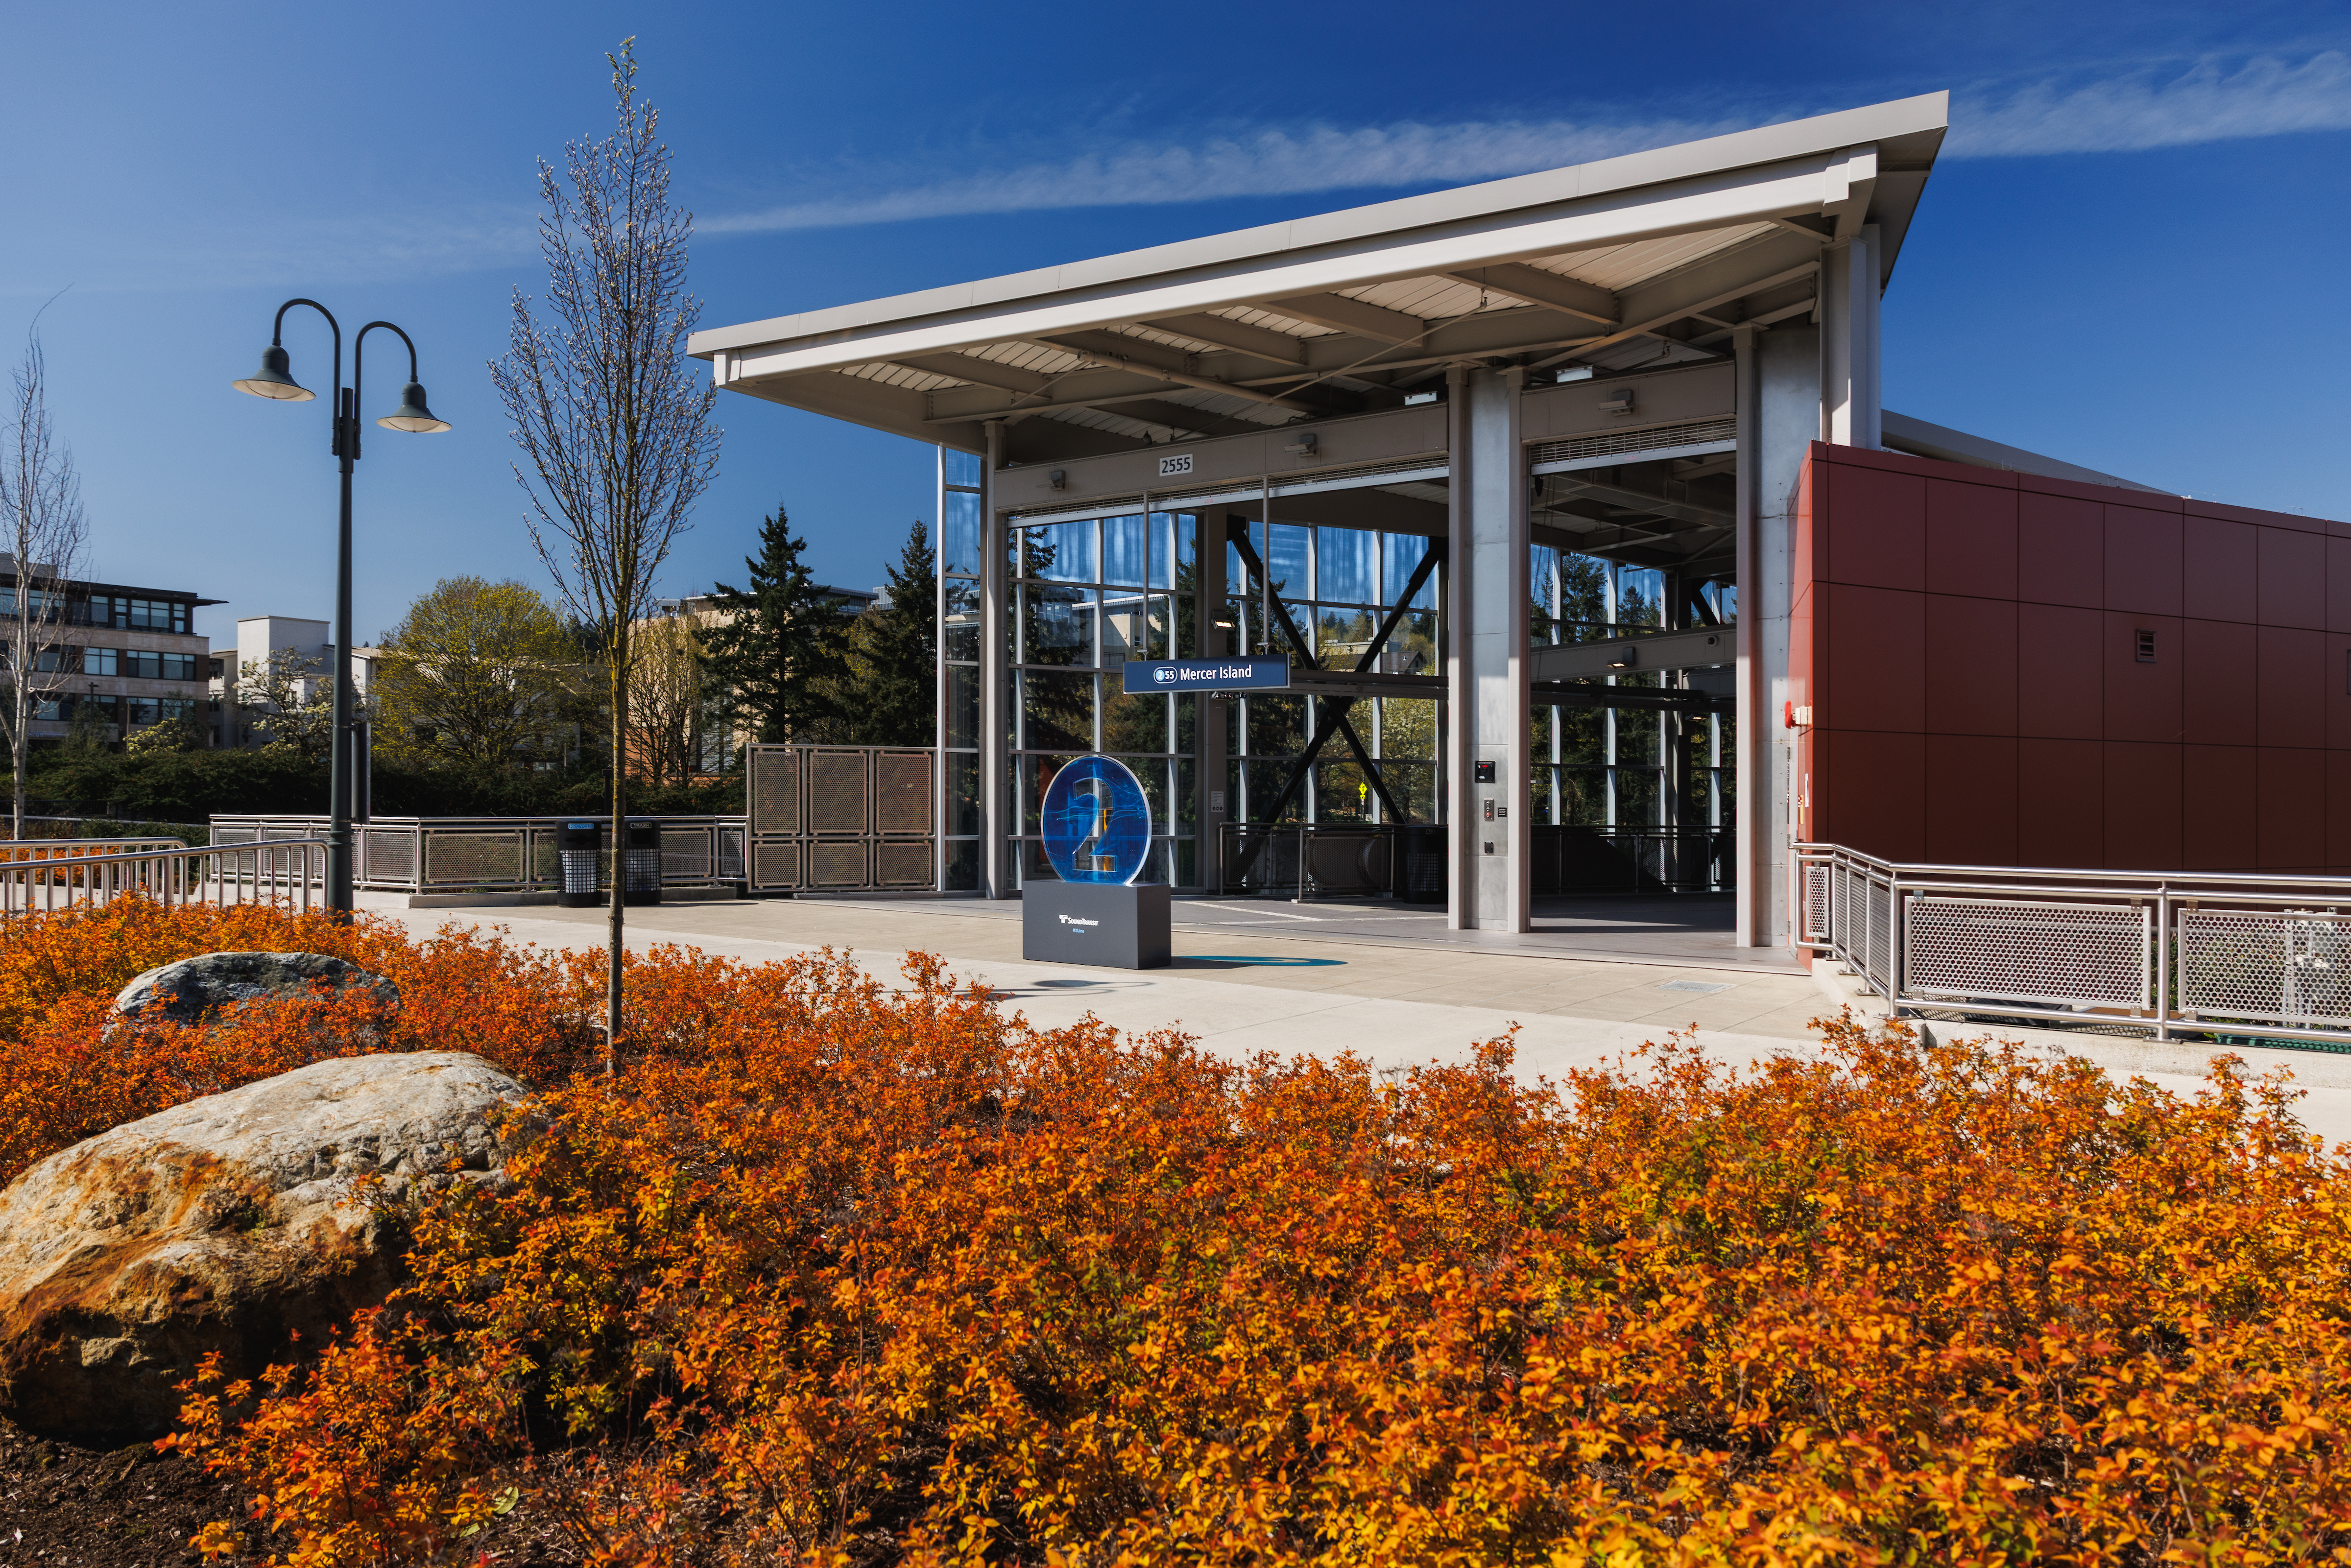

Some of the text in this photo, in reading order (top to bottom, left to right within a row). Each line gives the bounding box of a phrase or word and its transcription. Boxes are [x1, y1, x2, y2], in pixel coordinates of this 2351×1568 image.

[1162, 457, 1190, 473] 2555
[1165, 670, 1175, 679] 55
[1180, 668, 1217, 680] Mercer
[1220, 664, 1252, 679] Island
[1073, 777, 1118, 872] 2
